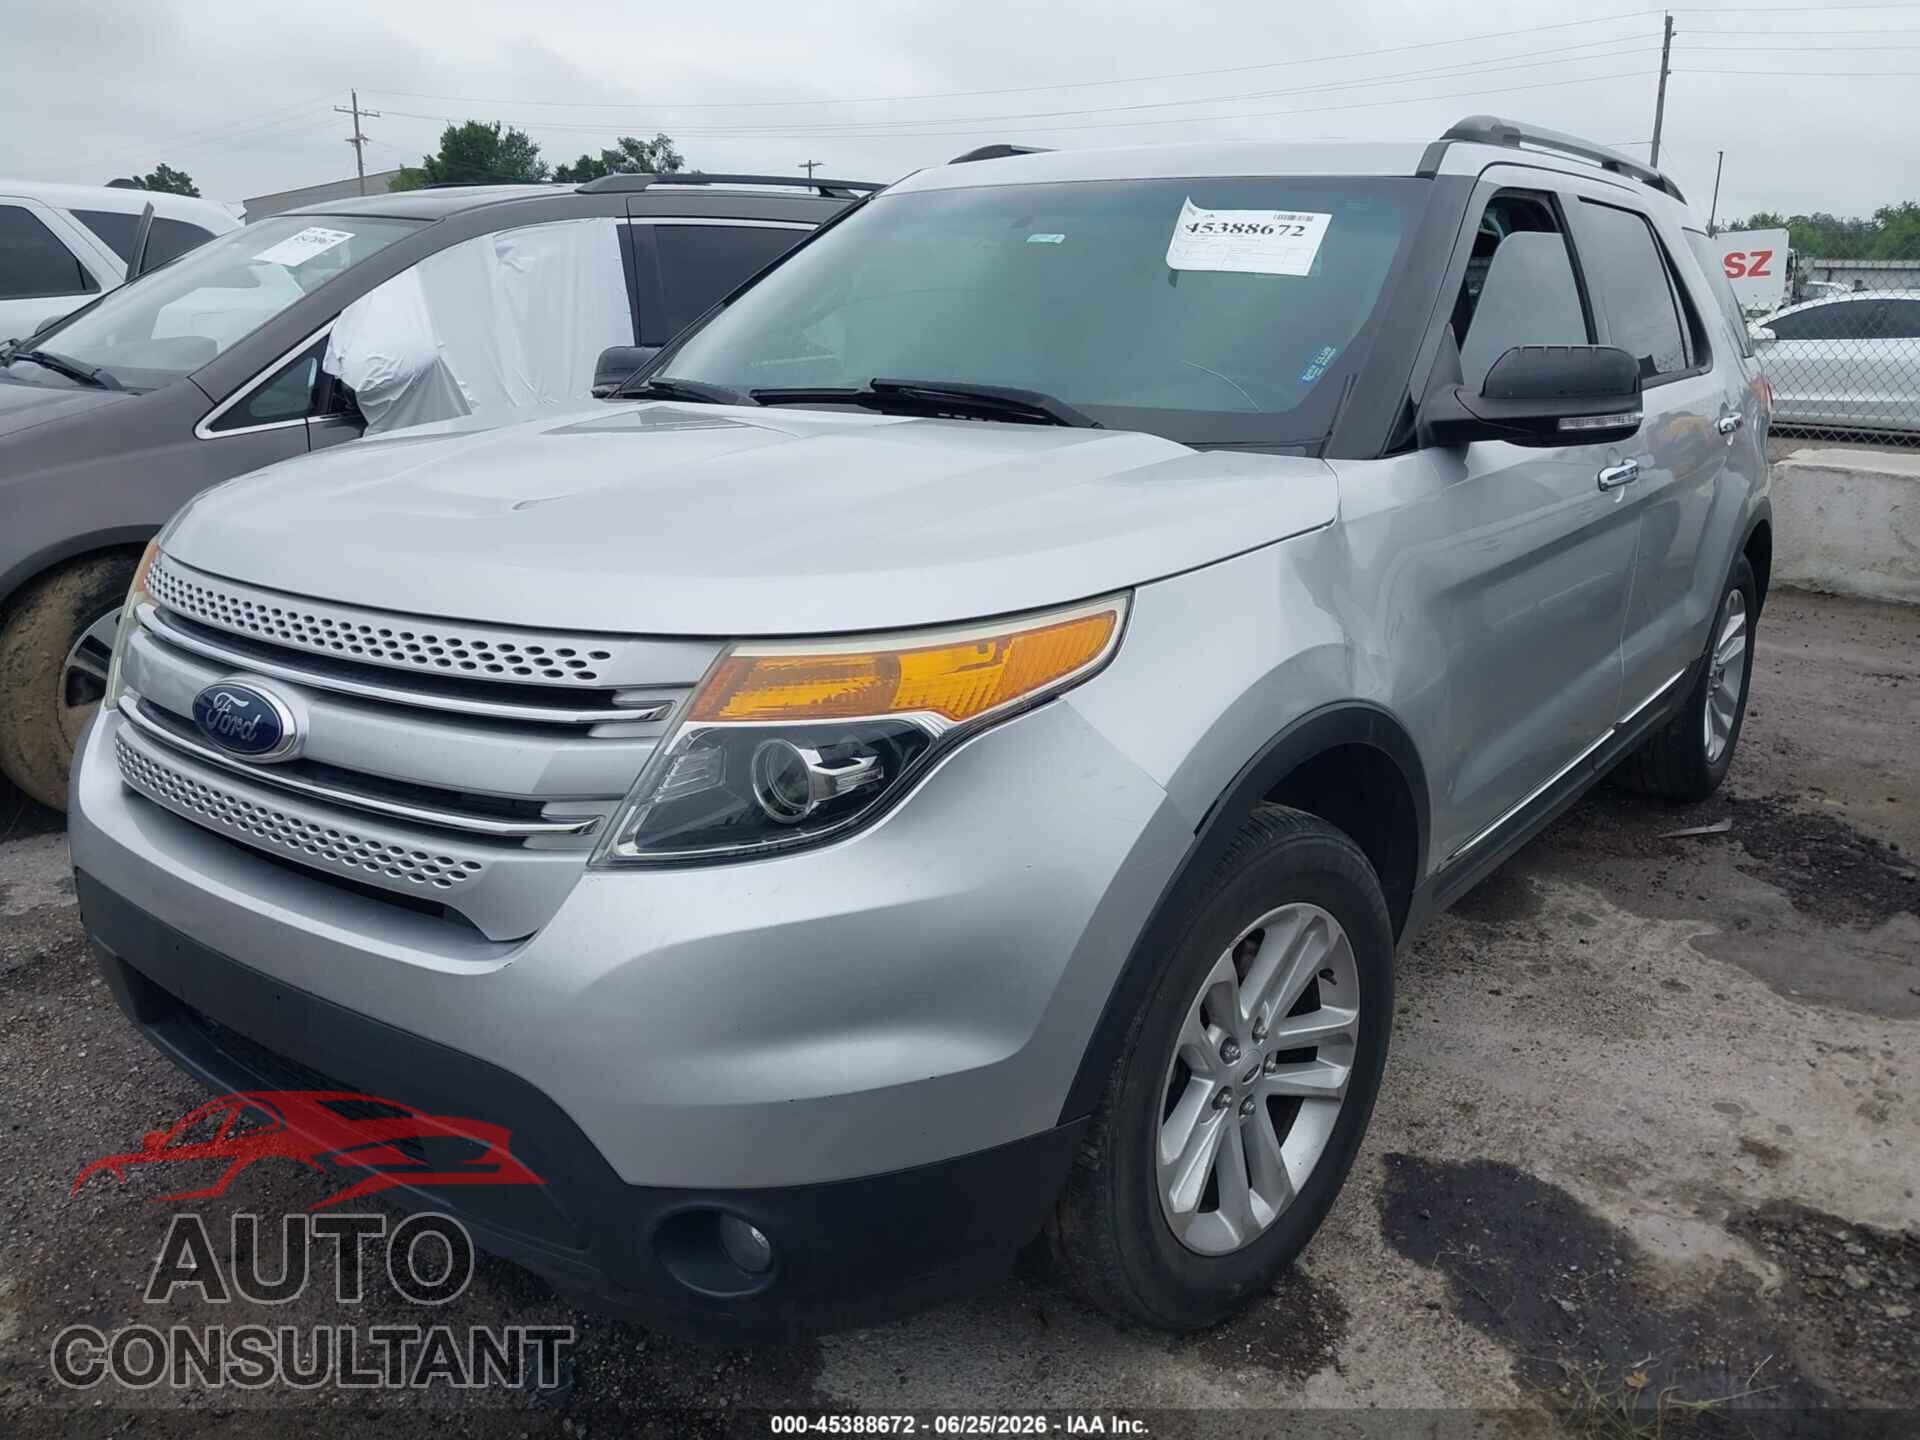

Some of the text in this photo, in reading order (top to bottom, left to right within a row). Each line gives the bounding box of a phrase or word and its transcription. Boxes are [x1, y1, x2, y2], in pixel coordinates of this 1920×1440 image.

[1185, 222, 1306, 237] 45388672
[1724, 250, 1773, 278] SZ
[206, 692, 262, 741] Ford
